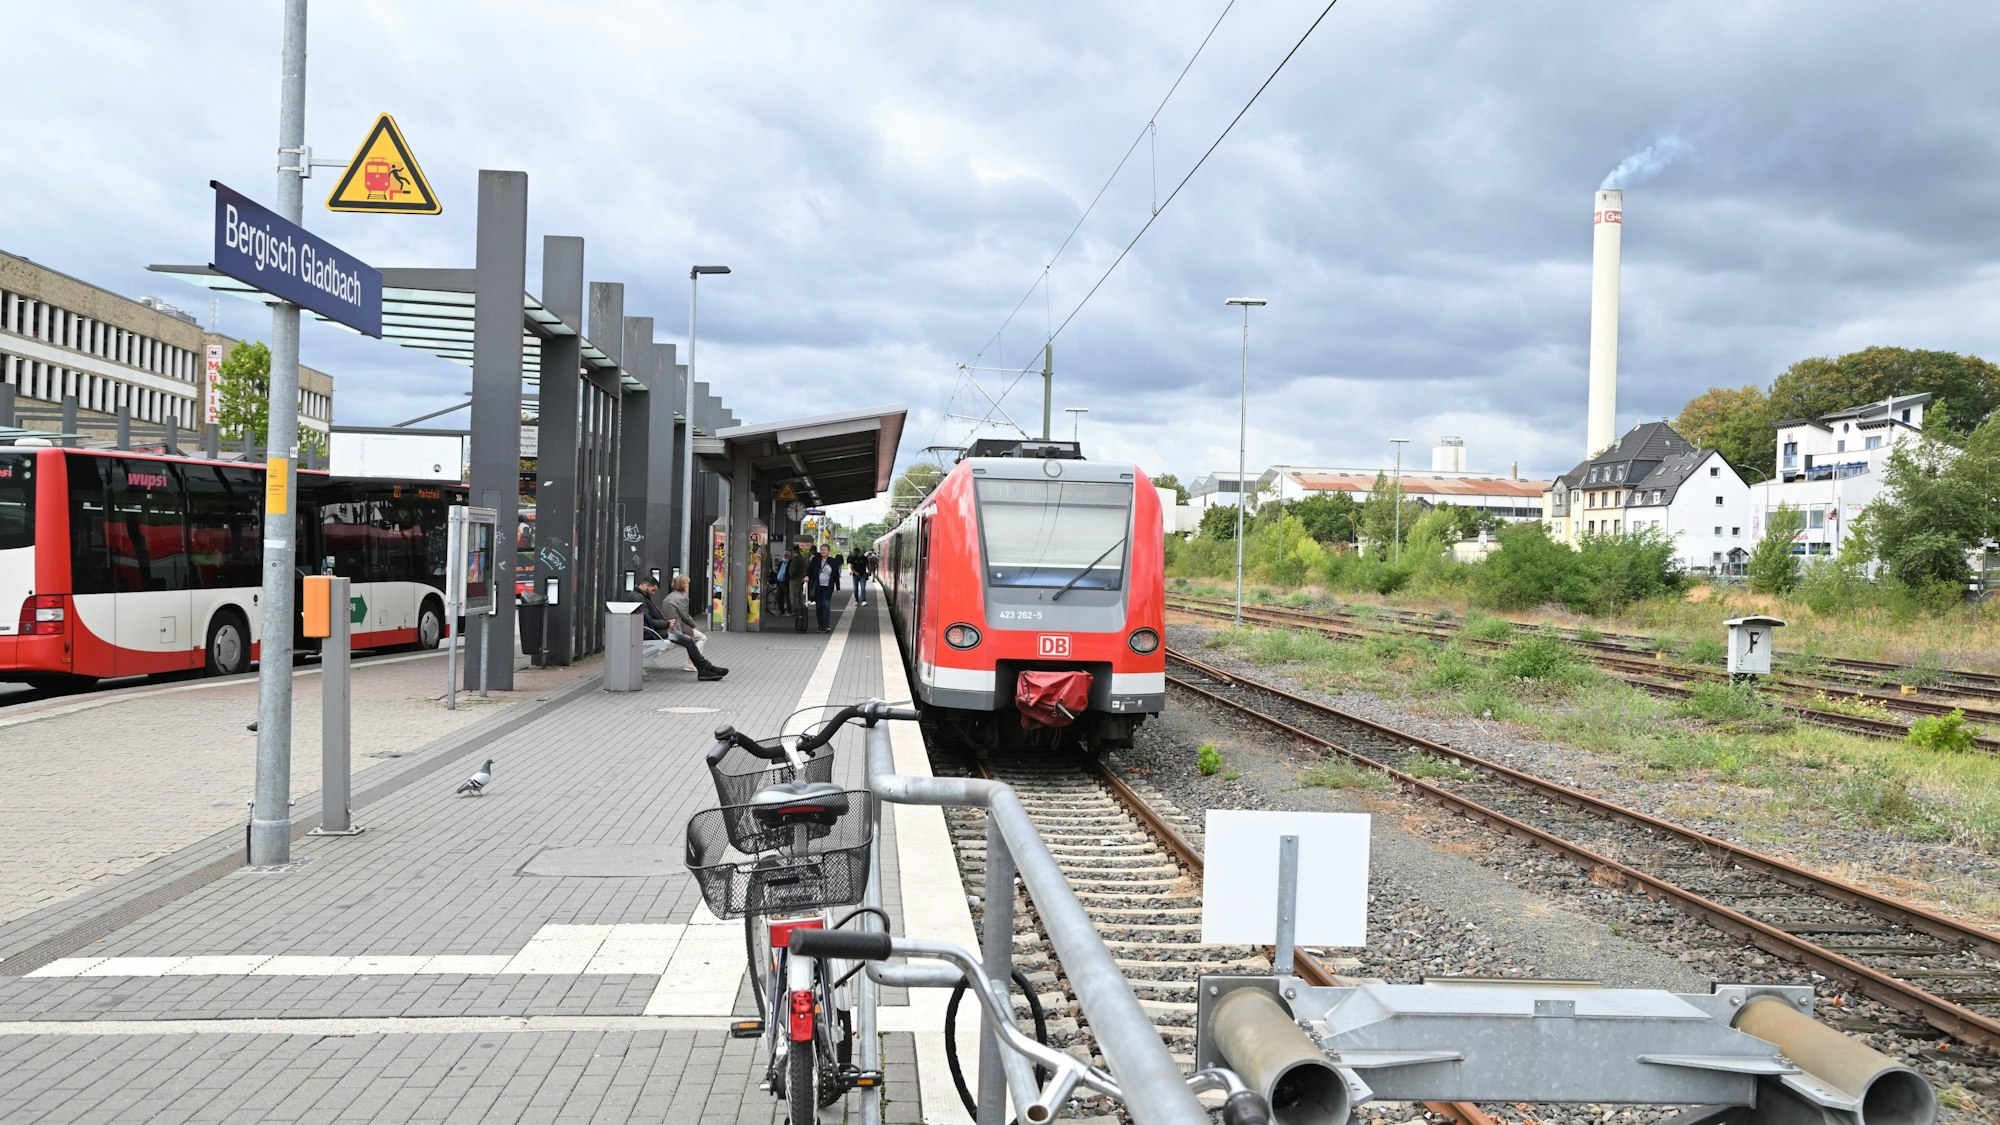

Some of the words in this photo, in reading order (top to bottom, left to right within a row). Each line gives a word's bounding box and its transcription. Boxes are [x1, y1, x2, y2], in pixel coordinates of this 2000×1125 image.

[226, 203, 296, 276] Bergisch
[301, 243, 361, 307] Gladbach
[128, 469, 167, 490] wupsi
[1000, 611, 1015, 619] 423
[1018, 611, 1043, 619] 262-5
[1042, 637, 1067, 653] DB
[1750, 632, 1759, 653] F
